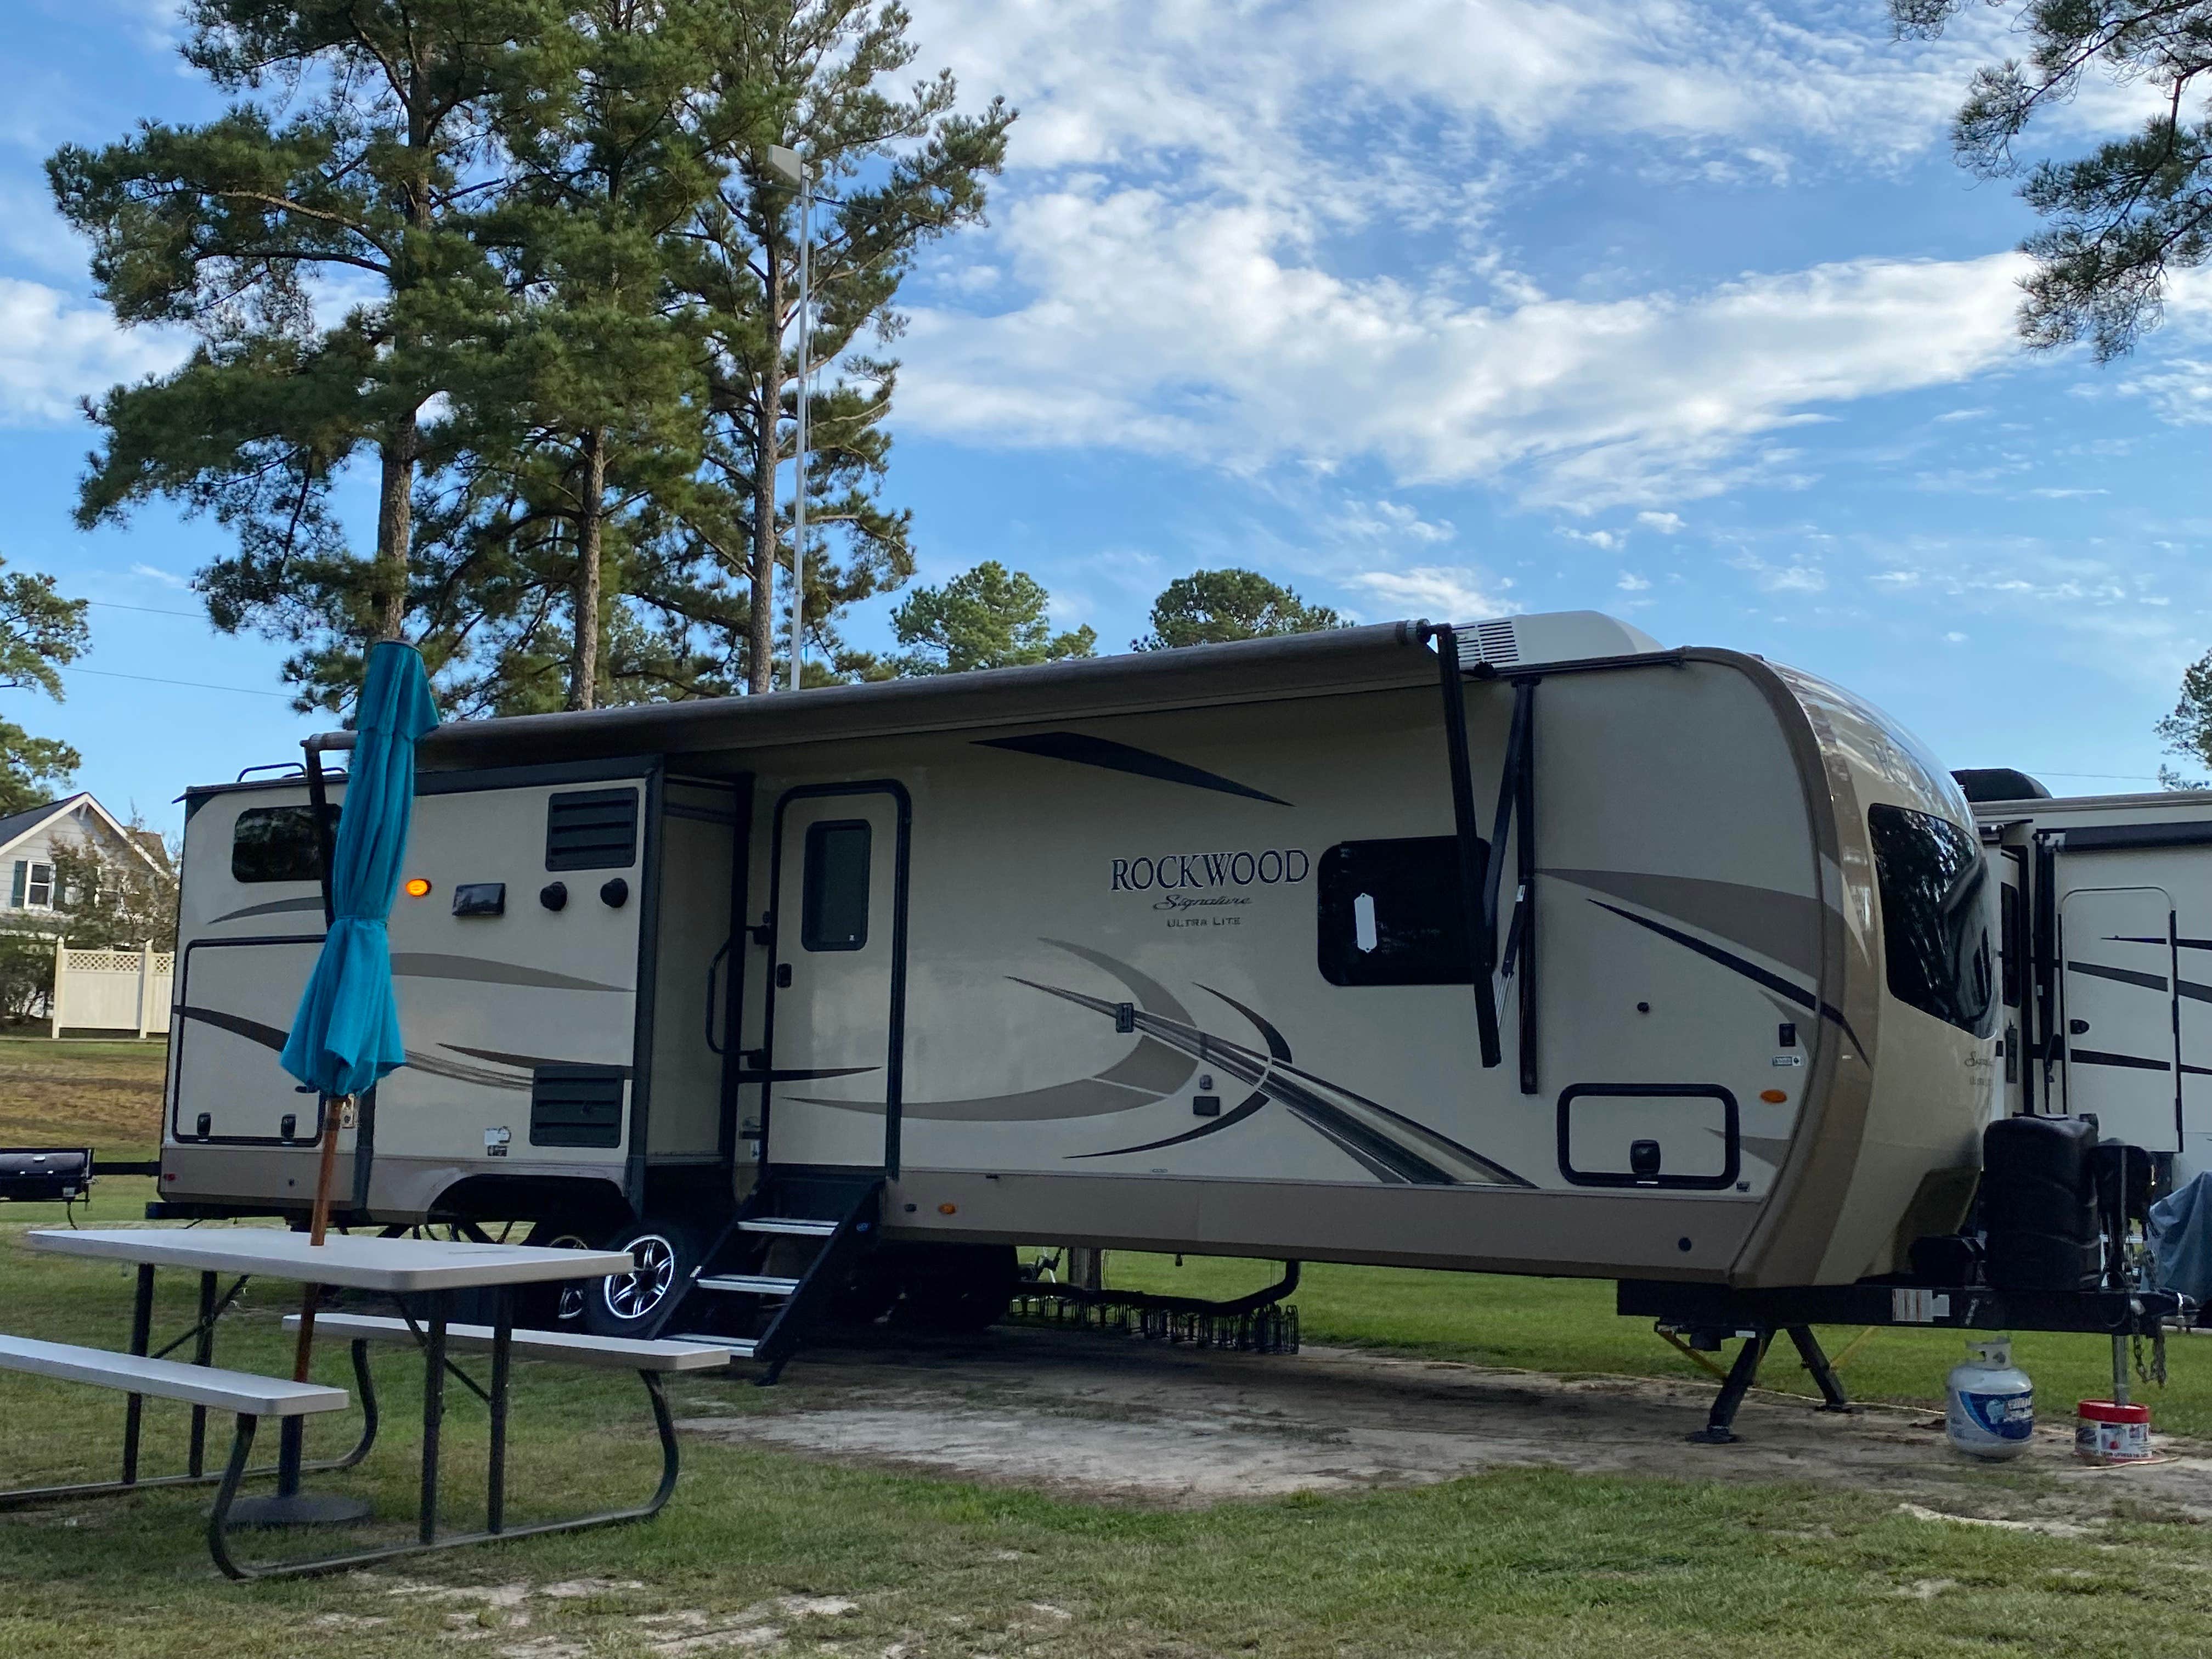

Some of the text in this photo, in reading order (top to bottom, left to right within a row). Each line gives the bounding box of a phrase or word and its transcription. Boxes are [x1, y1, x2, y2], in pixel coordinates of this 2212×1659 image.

[1111, 849, 1310, 891] ROCKWOOD
[1153, 894, 1254, 911] Signature
[1166, 917, 1242, 928] ULTRA LITE
